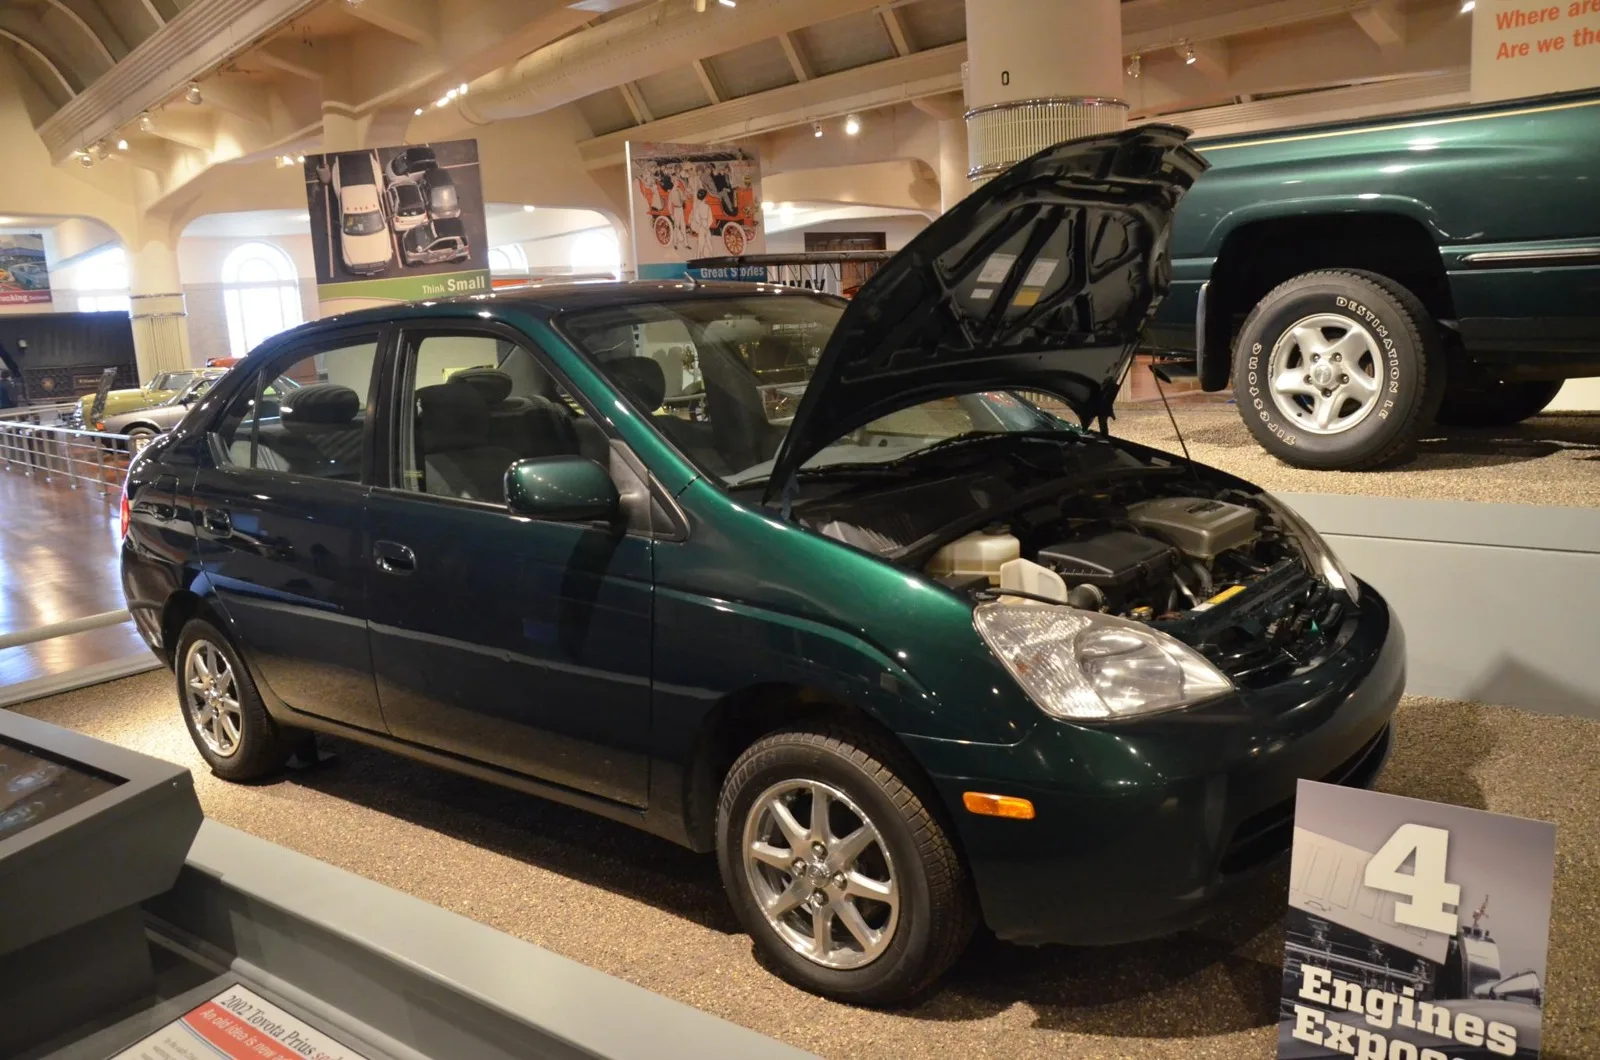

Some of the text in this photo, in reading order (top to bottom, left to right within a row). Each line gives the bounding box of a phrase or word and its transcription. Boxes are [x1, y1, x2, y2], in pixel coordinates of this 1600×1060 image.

[1496, 6, 1560, 31] Where
[1496, 41, 1530, 61] Are
[1537, 36, 1565, 53] we
[422, 275, 485, 294] Think Small
[700, 267, 728, 279] Great
[1336, 296, 1399, 420] DESTINATION LE
[1364, 823, 1460, 936] 4
[200, 1008, 217, 1020] An
[212, 1017, 234, 1030] old
[225, 1024, 249, 1041] idea
[244, 1035, 258, 1047] is
[252, 1042, 278, 1058] new
[221, 995, 253, 1016] 2002
[281, 1030, 317, 1056] Prius
[1292, 1004, 1466, 1060] Expo
[1299, 963, 1518, 1057] Engines
